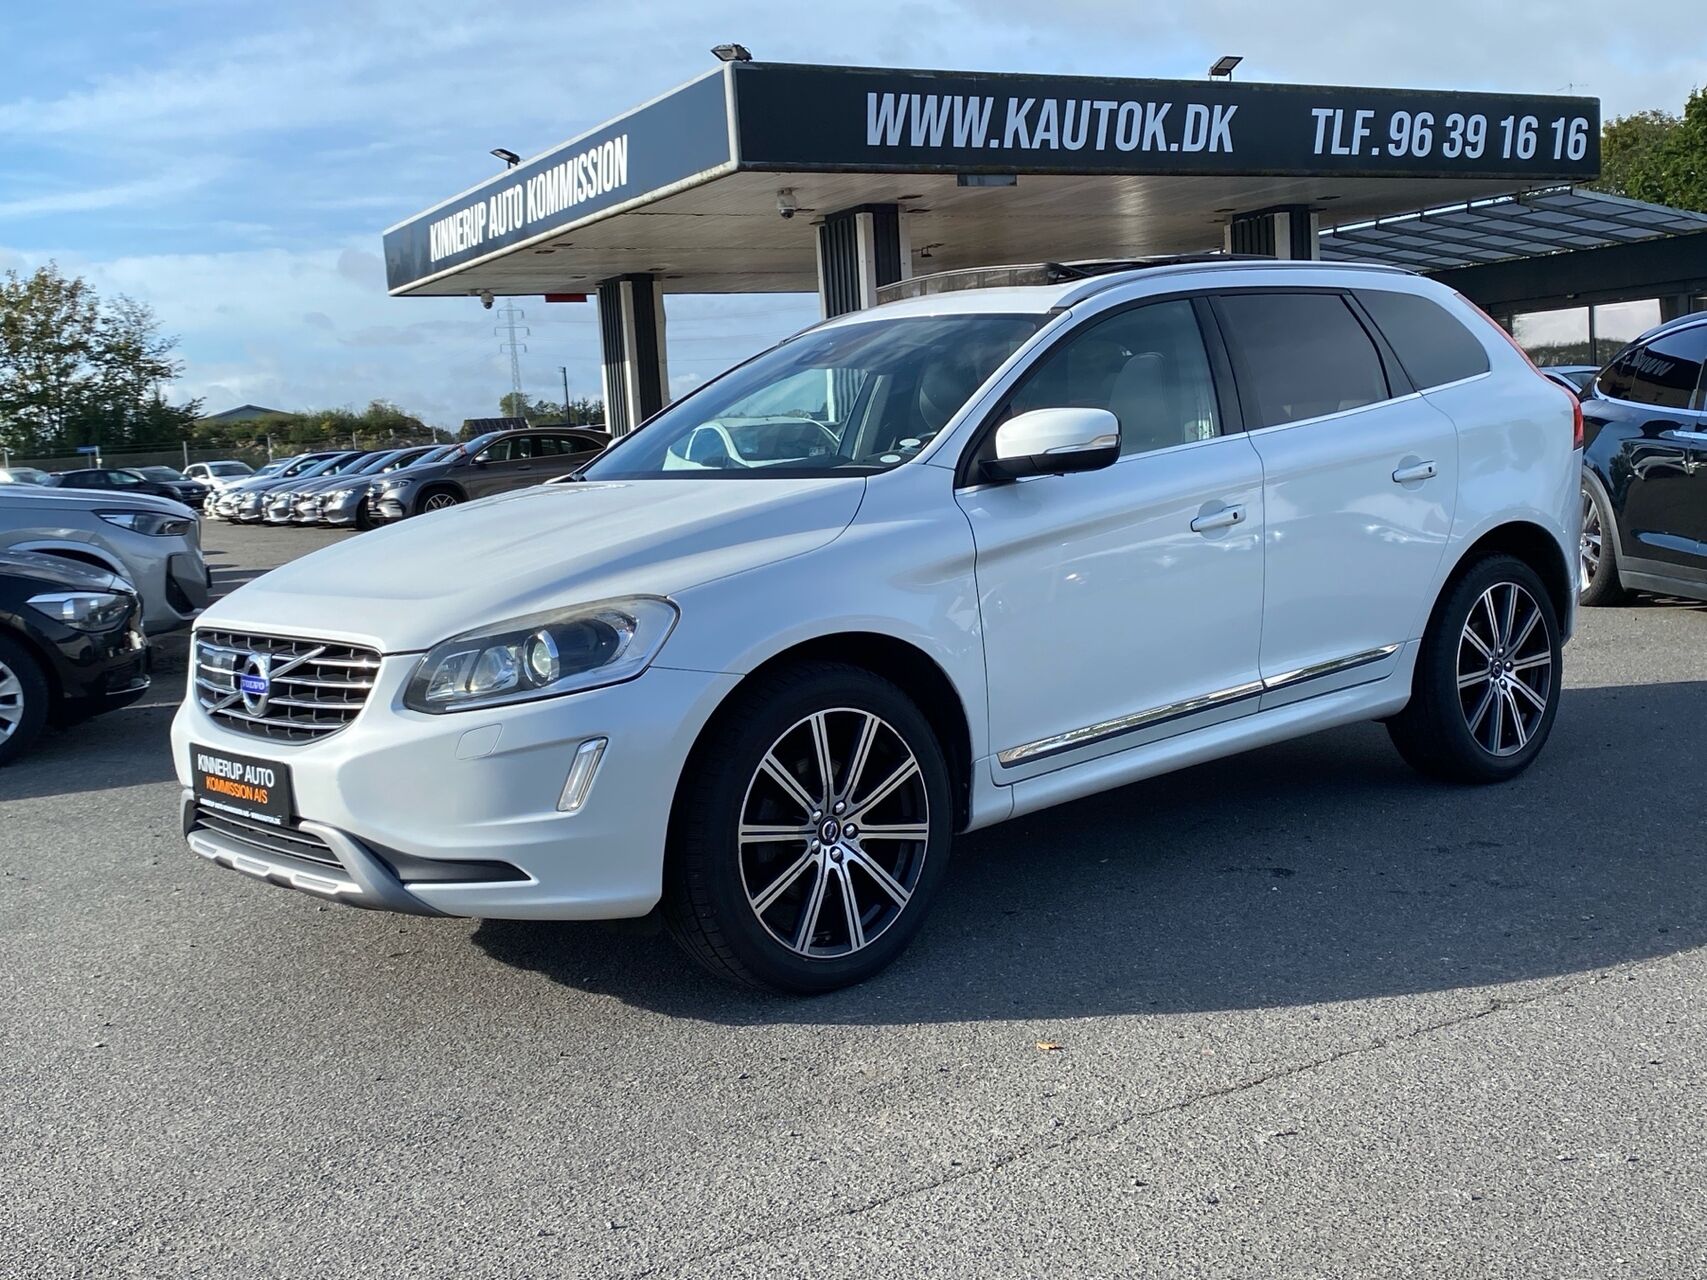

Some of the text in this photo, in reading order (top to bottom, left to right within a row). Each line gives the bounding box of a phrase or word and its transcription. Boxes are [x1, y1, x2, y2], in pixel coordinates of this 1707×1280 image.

[866, 92, 1238, 153] WWW.KAUTOK.DK
[1311, 108, 1589, 161] TLF. 96 39 16 16
[429, 134, 628, 263] KINNERUP AUTO KOMMISSION
[197, 753, 275, 788] KINNERUP AUTO
[205, 775, 253, 800] KOMMISSION
